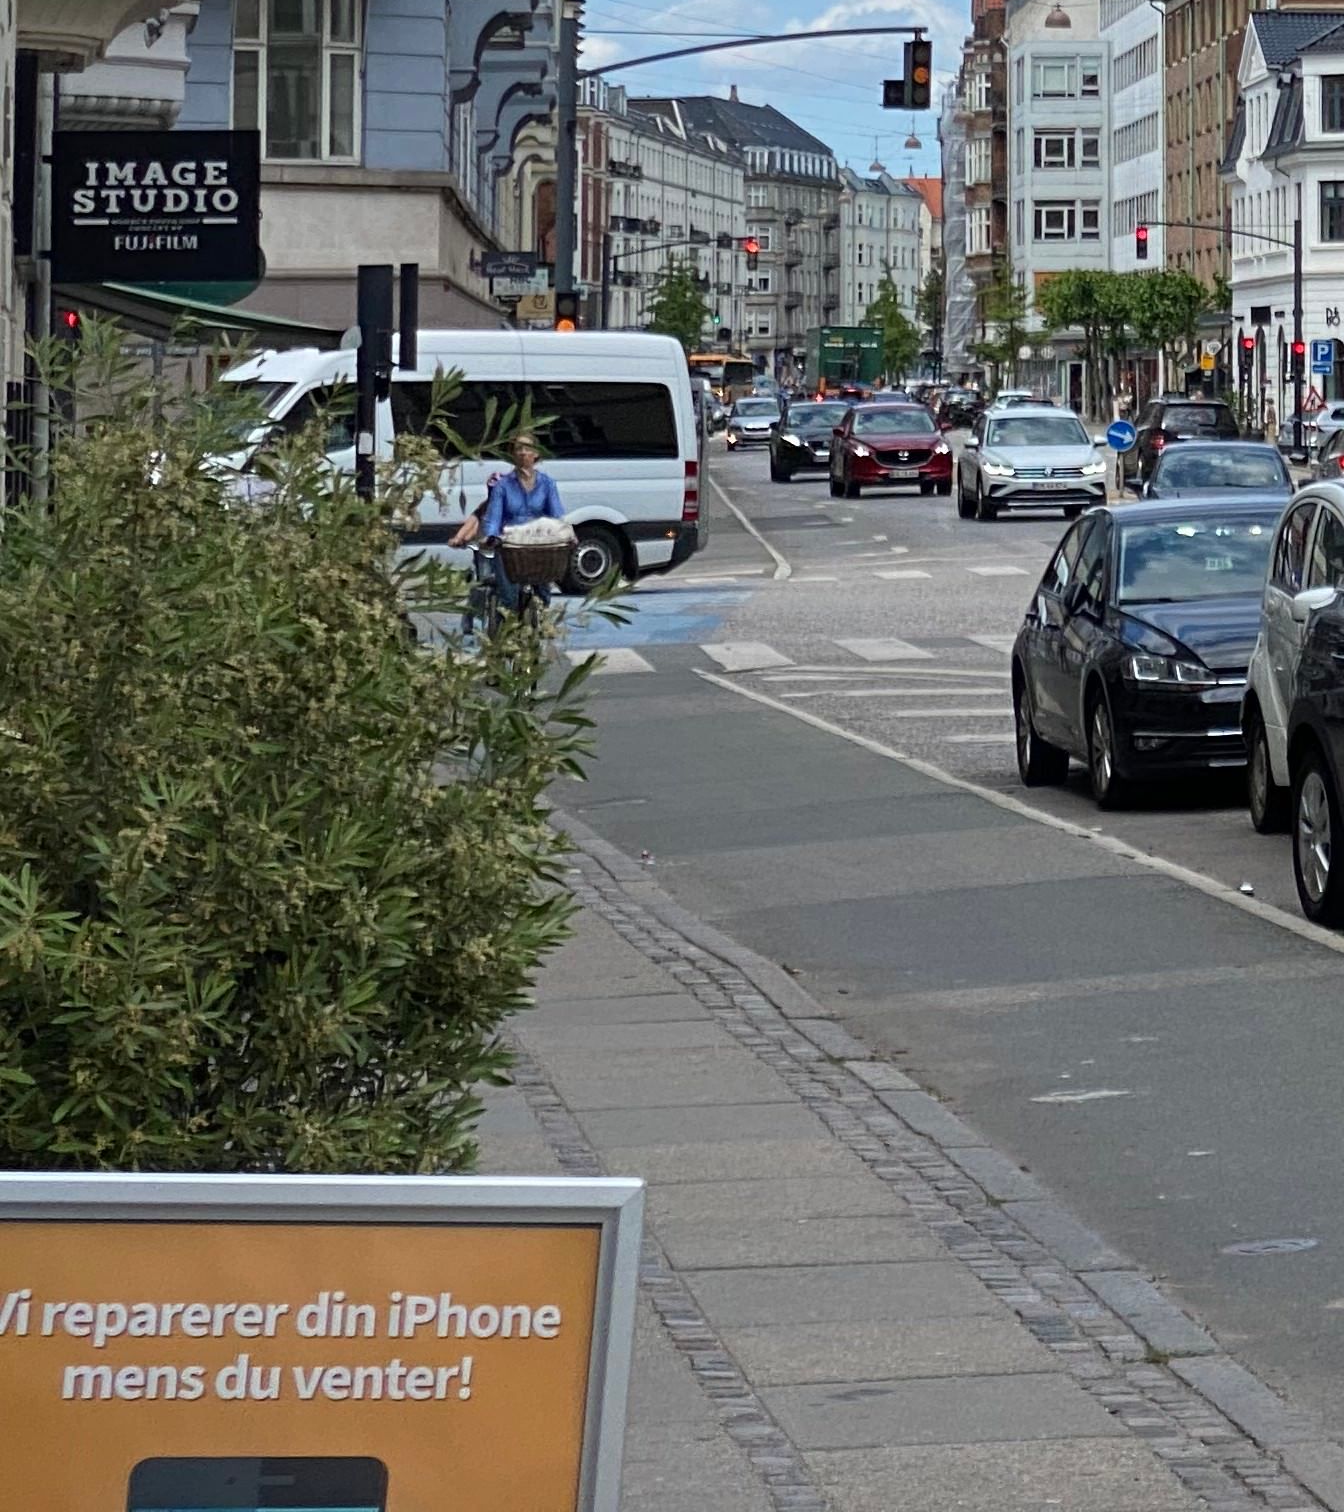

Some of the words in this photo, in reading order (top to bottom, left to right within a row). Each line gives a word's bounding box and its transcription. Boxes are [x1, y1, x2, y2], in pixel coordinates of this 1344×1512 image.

[85, 162, 228, 186] IMAGE
[73, 189, 239, 213] STUDIO
[114, 235, 198, 251] FUJIFILM
[1317, 344, 1329, 361] P
[41, 1294, 289, 1348] reparerer
[297, 1292, 376, 1338] din
[388, 1292, 562, 1339] iPhone
[61, 1360, 206, 1400] mens
[215, 1354, 281, 1400] du
[293, 1356, 473, 1400] venter!
